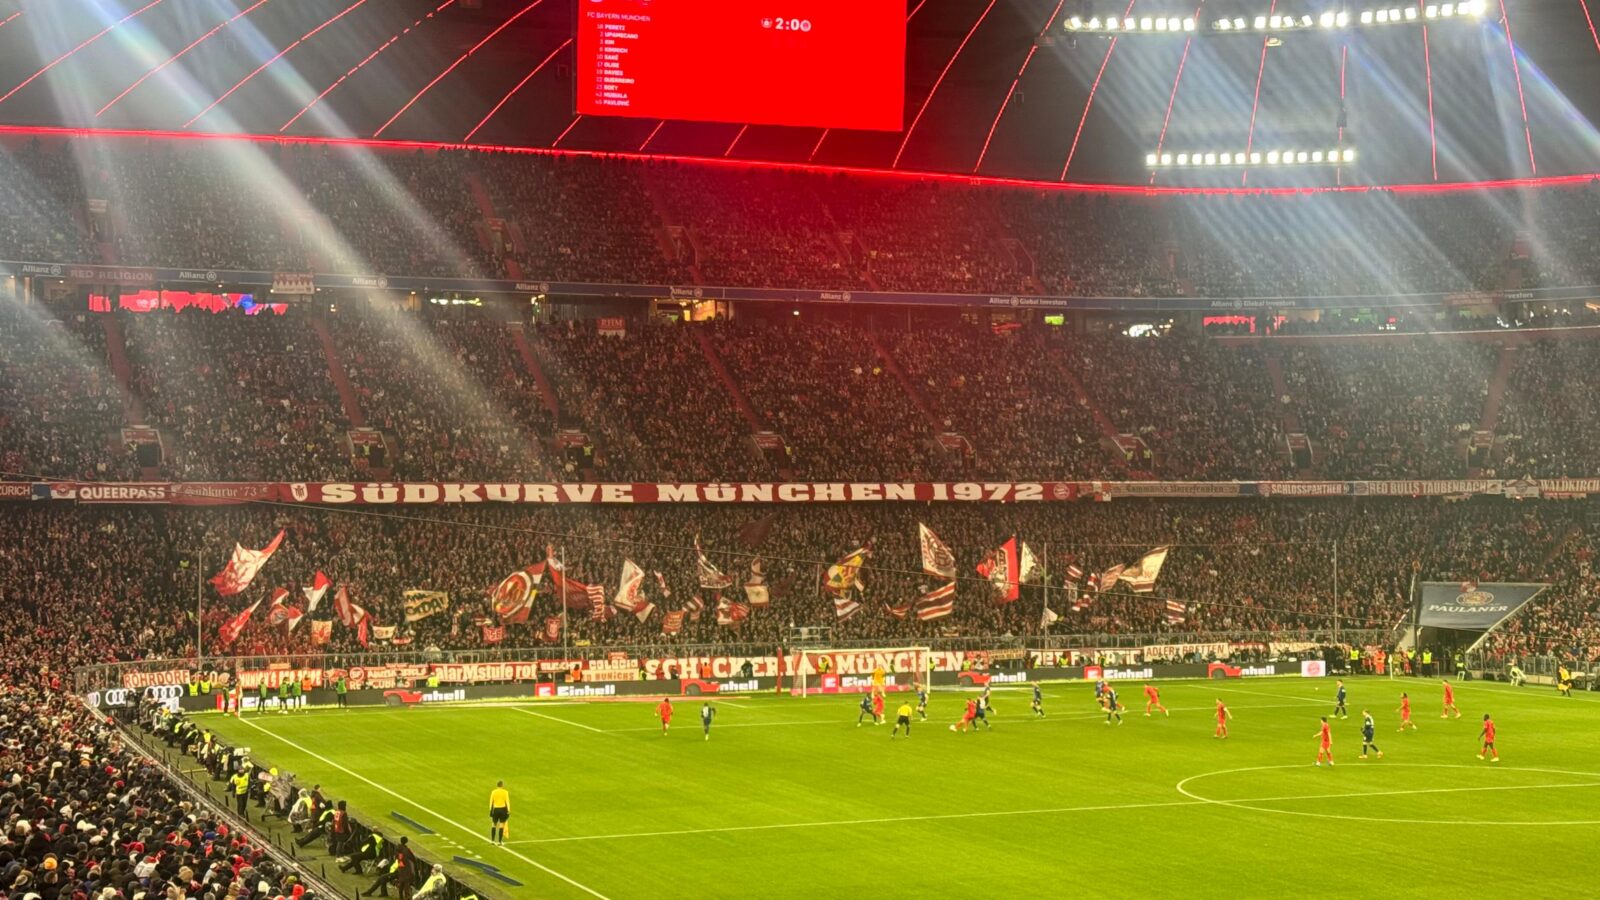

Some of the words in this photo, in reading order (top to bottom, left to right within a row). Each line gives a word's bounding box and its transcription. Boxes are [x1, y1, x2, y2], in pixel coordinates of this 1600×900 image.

[22, 264, 49, 274] Allianz
[71, 270, 94, 279] RED
[99, 270, 153, 282] RELIGION
[179, 271, 204, 280] Allianz
[352, 278, 377, 286] Allianz
[515, 283, 539, 291] Allianz
[79, 486, 166, 500] QUEERPASS
[321, 482, 634, 503] SÜDKURVE
[656, 482, 917, 503] MÜNCHEN
[931, 482, 1044, 502] 1972
[1271, 484, 1342, 496] SCHLOSSPANTHER
[1369, 482, 1388, 494] RED
[1391, 481, 1419, 494] BULLS
[1422, 480, 1486, 494] TAUBENBACH
[1429, 604, 1508, 613] PAULANER
[1146, 646, 1175, 657] ADLER
[1182, 644, 1224, 656] BRETTEN
[836, 651, 964, 676] MÜNCHEN
[516, 664, 537, 680] rot
[1103, 668, 1153, 680] Einhell
[124, 670, 190, 688] RÖHRDORF
[842, 675, 895, 688] Einhll
[557, 684, 615, 696] Einhell
